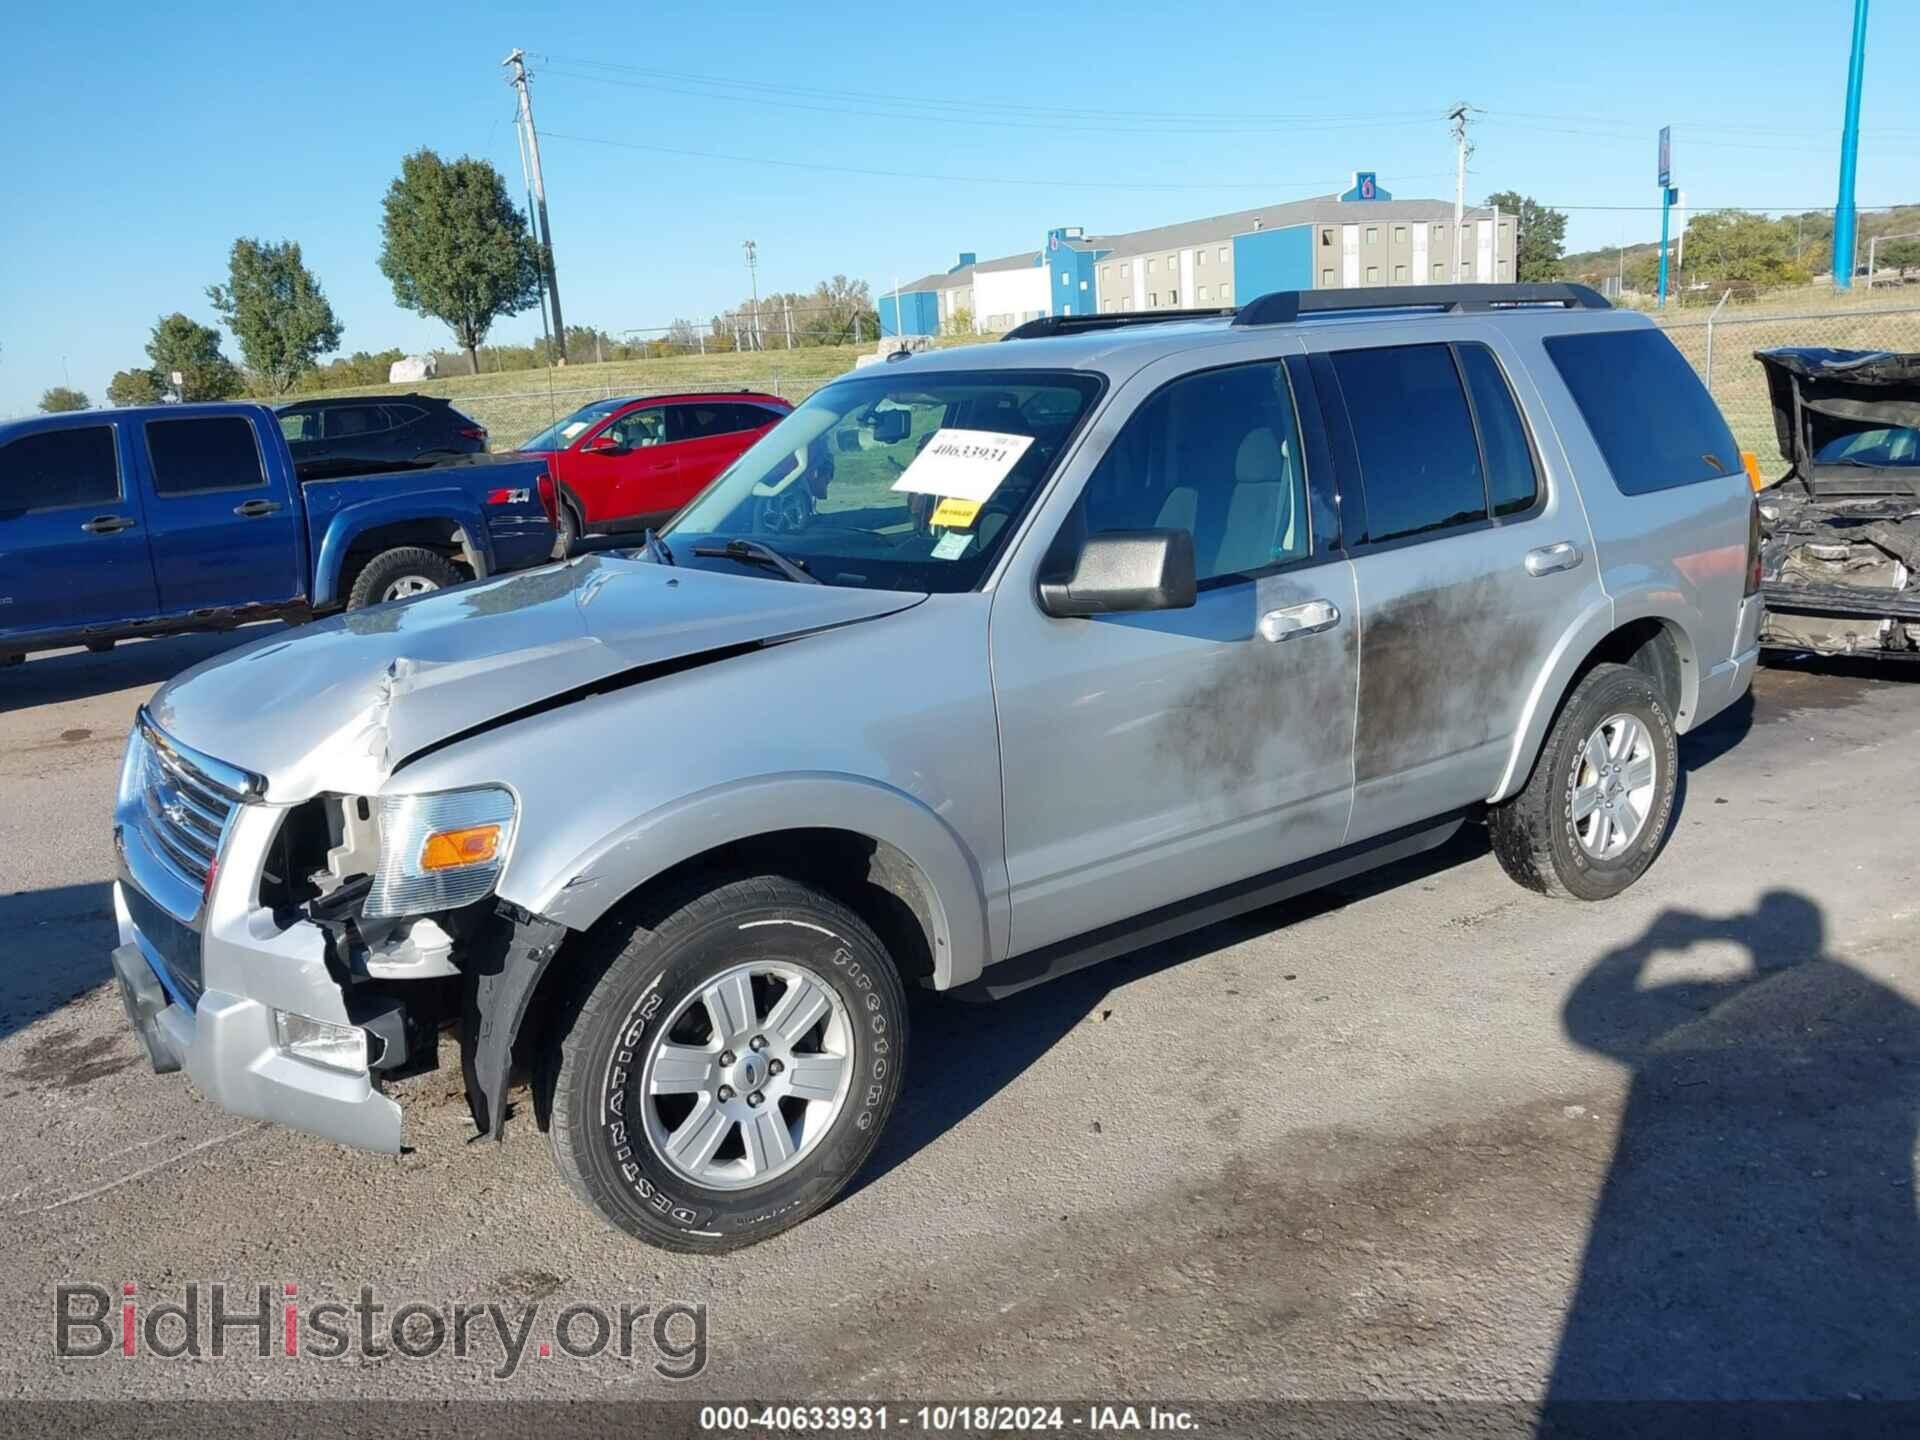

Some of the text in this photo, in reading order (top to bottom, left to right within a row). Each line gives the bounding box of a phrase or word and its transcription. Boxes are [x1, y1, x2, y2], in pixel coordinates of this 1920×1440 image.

[1362, 176, 1374, 198] 6
[931, 444, 1008, 462] 40633931
[610, 994, 697, 1225] DESTINATION
